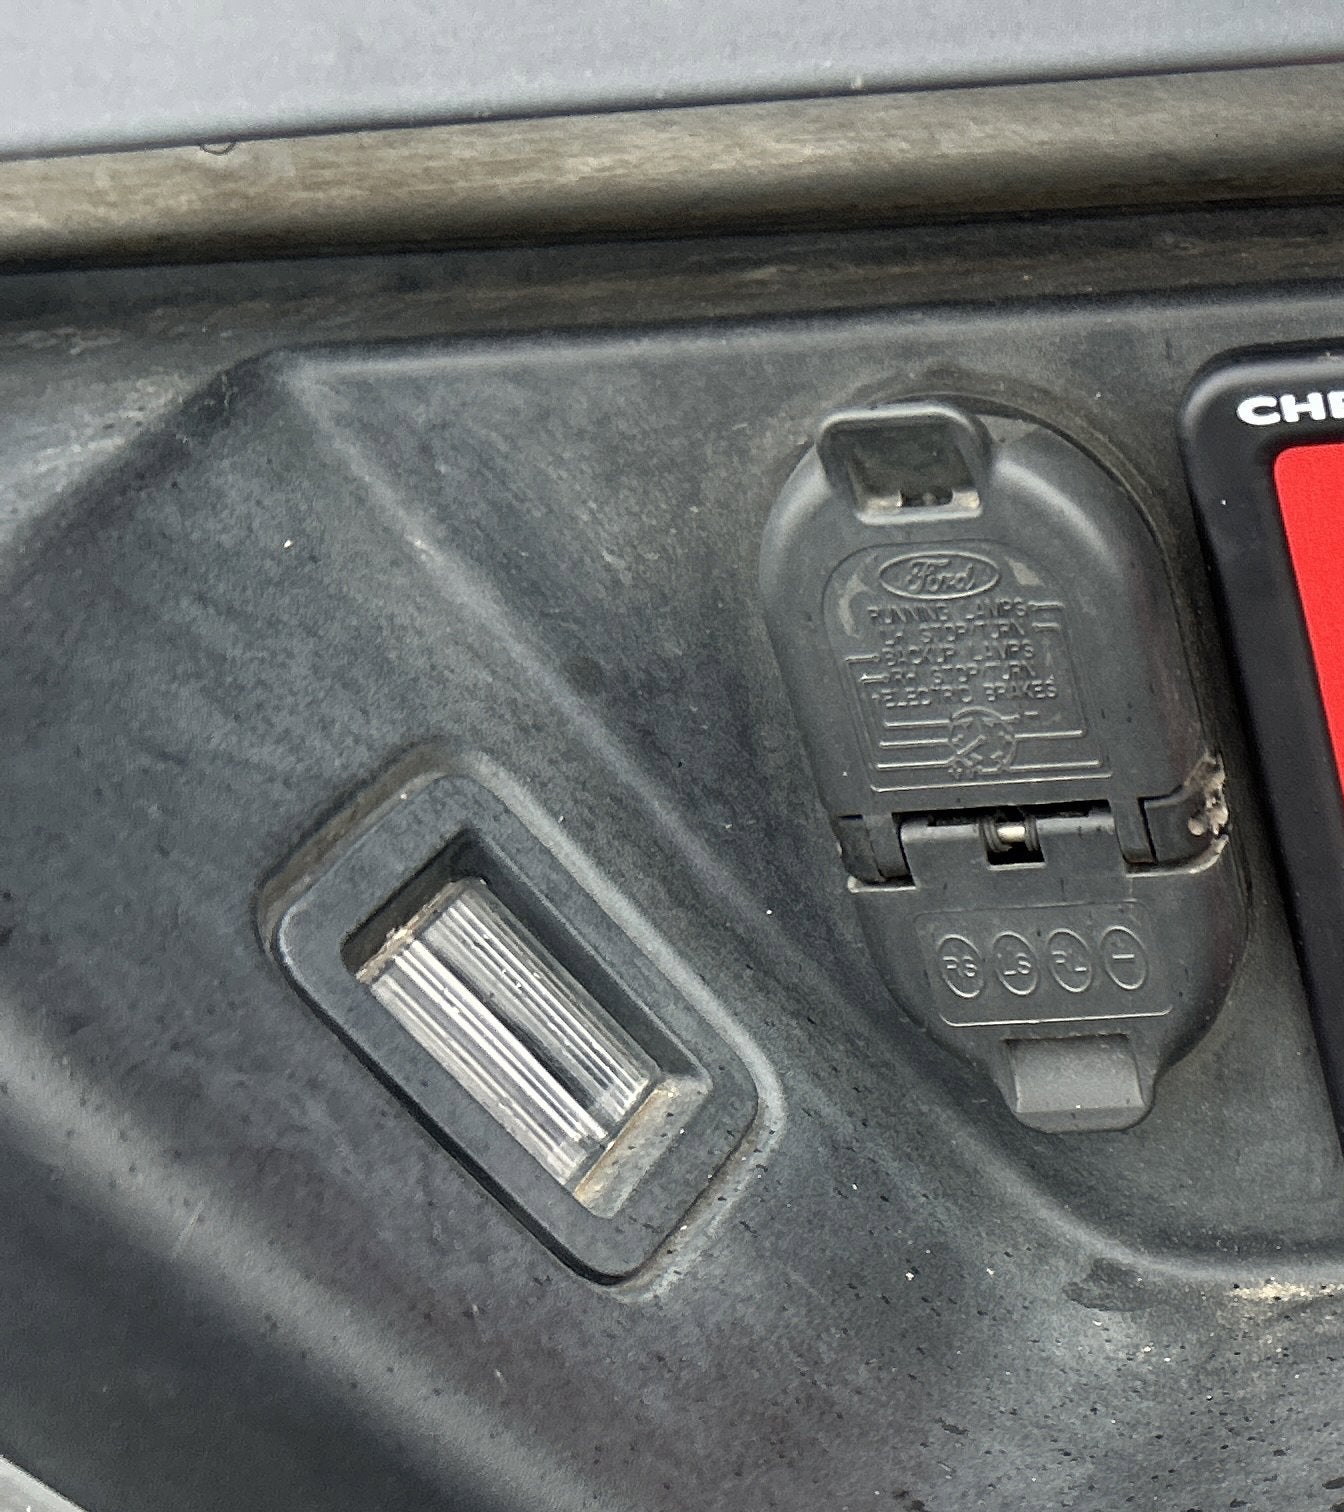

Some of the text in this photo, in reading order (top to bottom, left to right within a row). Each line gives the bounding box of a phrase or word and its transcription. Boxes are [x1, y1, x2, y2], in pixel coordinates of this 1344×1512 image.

[906, 557, 976, 594] Ford
[867, 597, 1027, 624] RUNNING LAMPS
[881, 640, 1034, 667] BACKUP LAMPS
[879, 679, 1058, 708] ELECTRIC BRAKES
